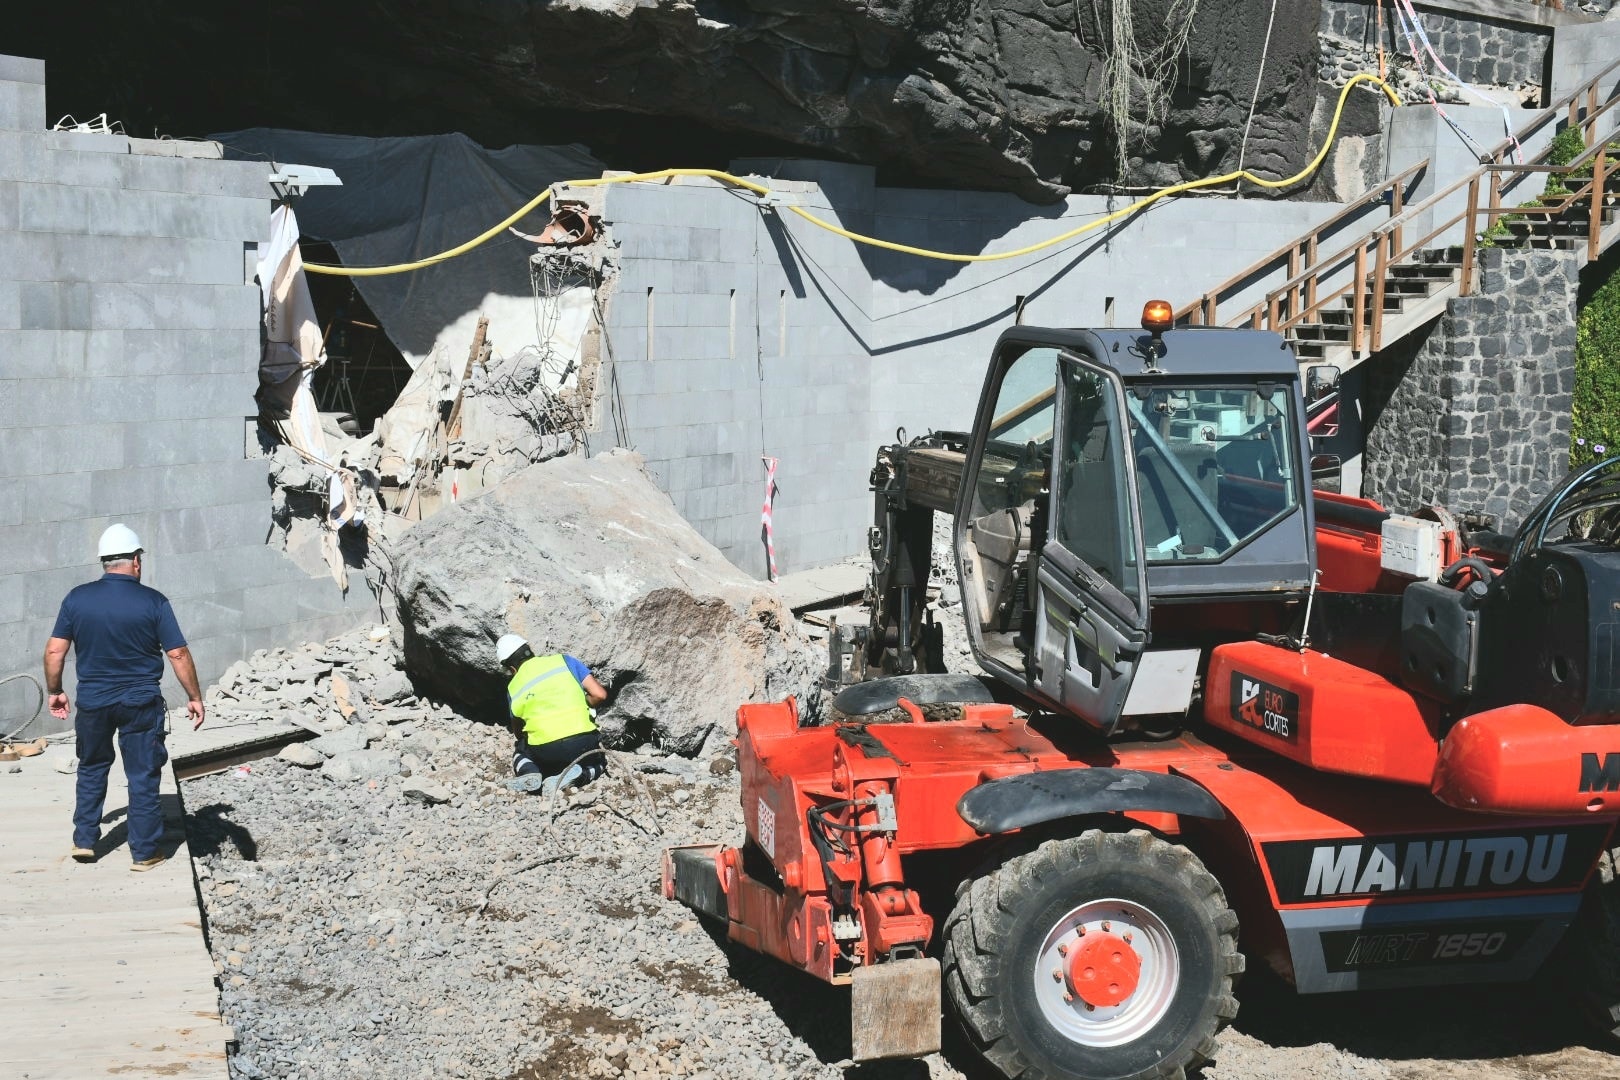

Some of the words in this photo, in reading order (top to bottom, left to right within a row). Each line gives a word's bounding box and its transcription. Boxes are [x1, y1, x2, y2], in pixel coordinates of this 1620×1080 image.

[1382, 538, 1416, 560] PAT
[1265, 690, 1283, 714] EURO
[1264, 710, 1289, 737] CORTES
[1303, 834, 1568, 896] MANITOU
[1345, 932, 1429, 965] MRT
[1432, 932, 1507, 959] 1850
